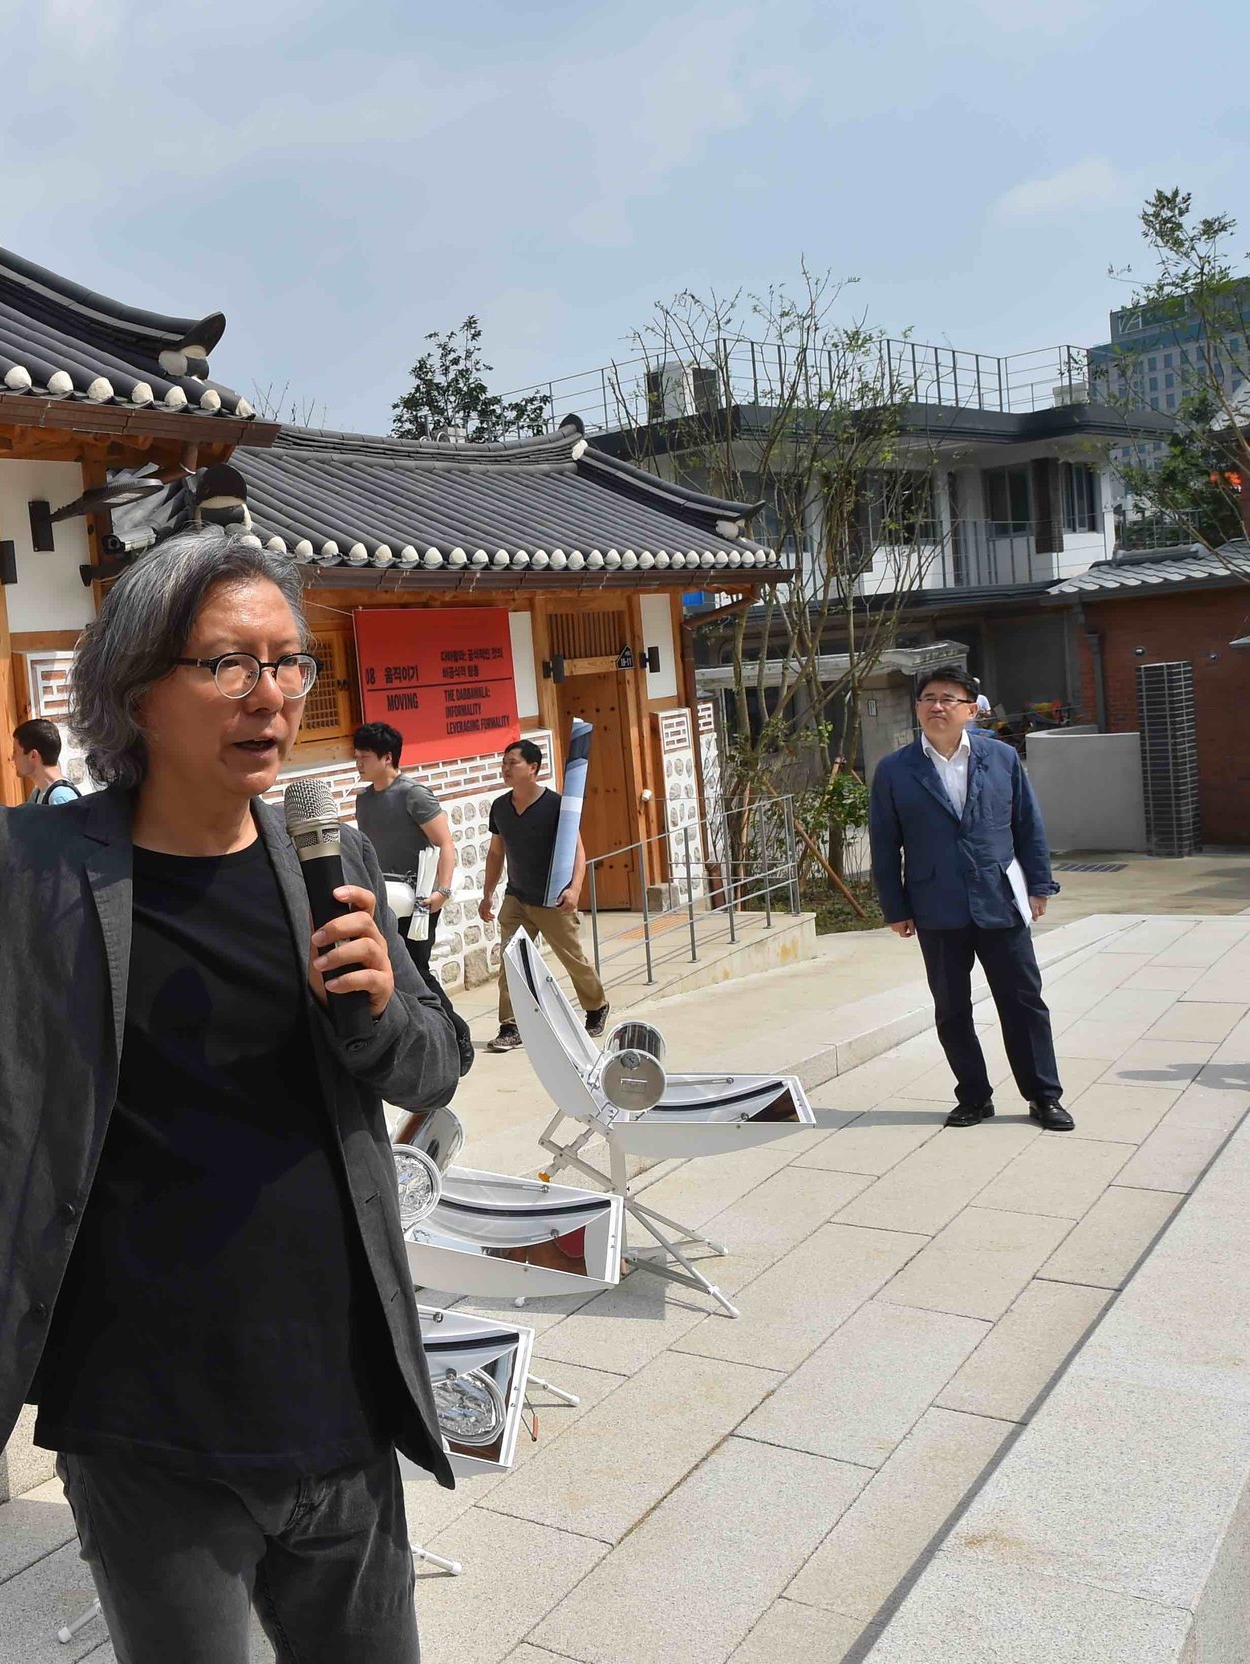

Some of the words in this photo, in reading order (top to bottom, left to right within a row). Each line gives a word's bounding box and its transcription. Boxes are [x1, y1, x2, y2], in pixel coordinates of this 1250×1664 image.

[384, 664, 419, 684] 움직이기
[387, 692, 419, 711] MOVING
[444, 689, 455, 702] THE
[445, 703, 481, 718] INFORMALITY
[446, 719, 479, 735] LEVERAGING
[480, 715, 510, 730] FORMALITY
